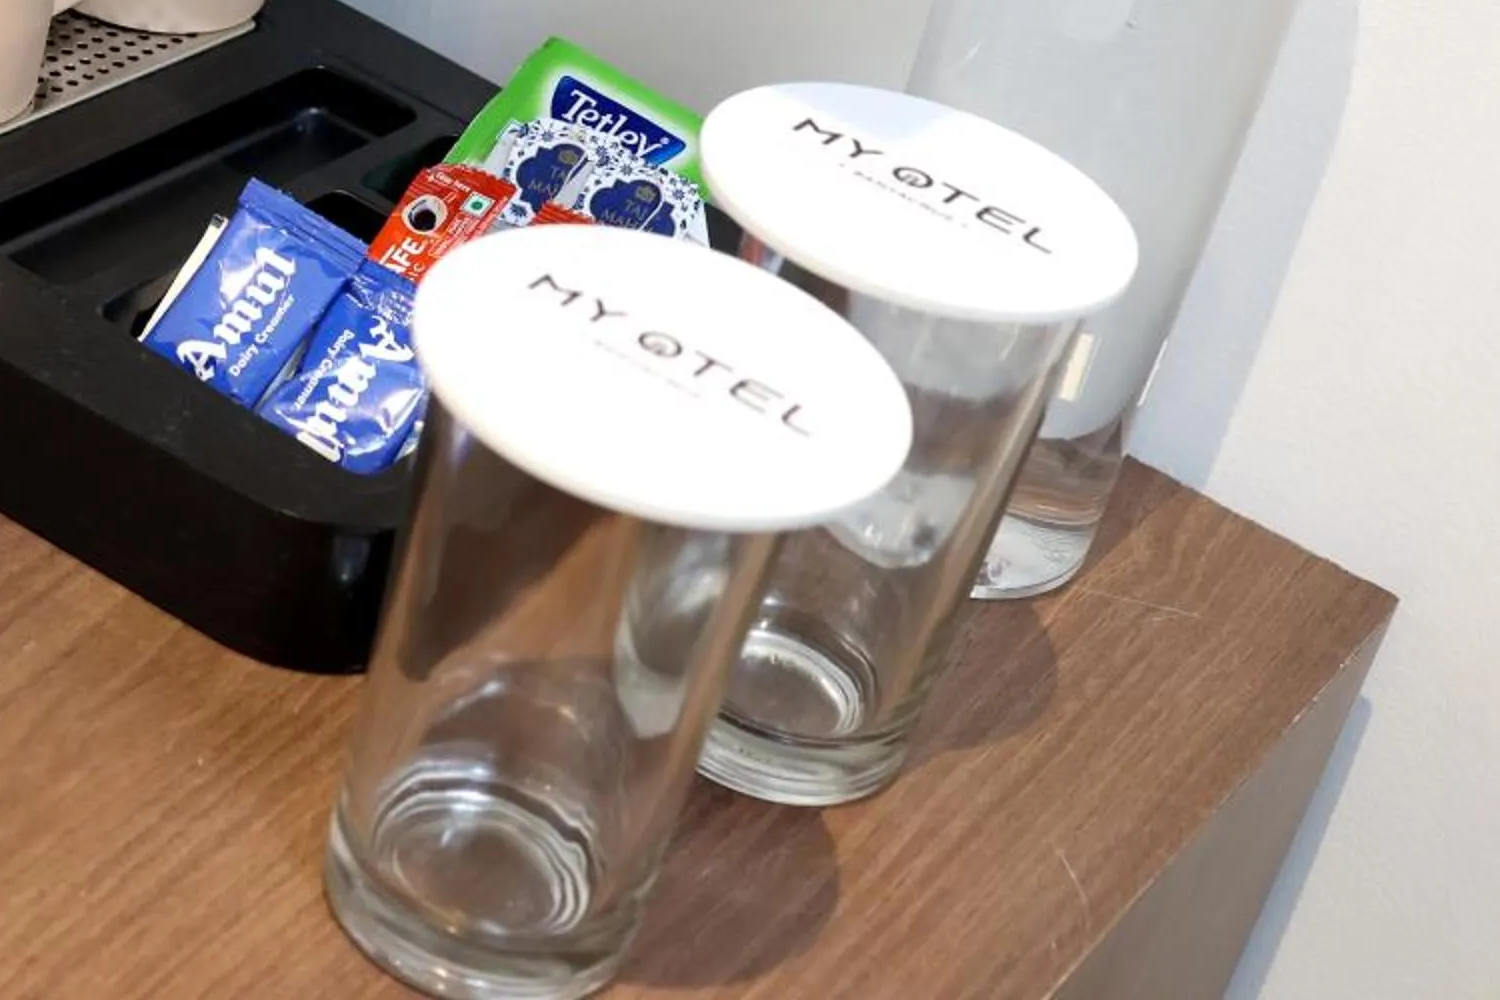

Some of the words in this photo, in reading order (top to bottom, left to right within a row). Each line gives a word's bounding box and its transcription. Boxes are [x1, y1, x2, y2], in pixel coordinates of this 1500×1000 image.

[561, 89, 662, 158] Tetley
[792, 117, 883, 158] MY
[177, 247, 296, 381] Amul
[527, 273, 628, 322] MY
[229, 343, 259, 378] Dairy
